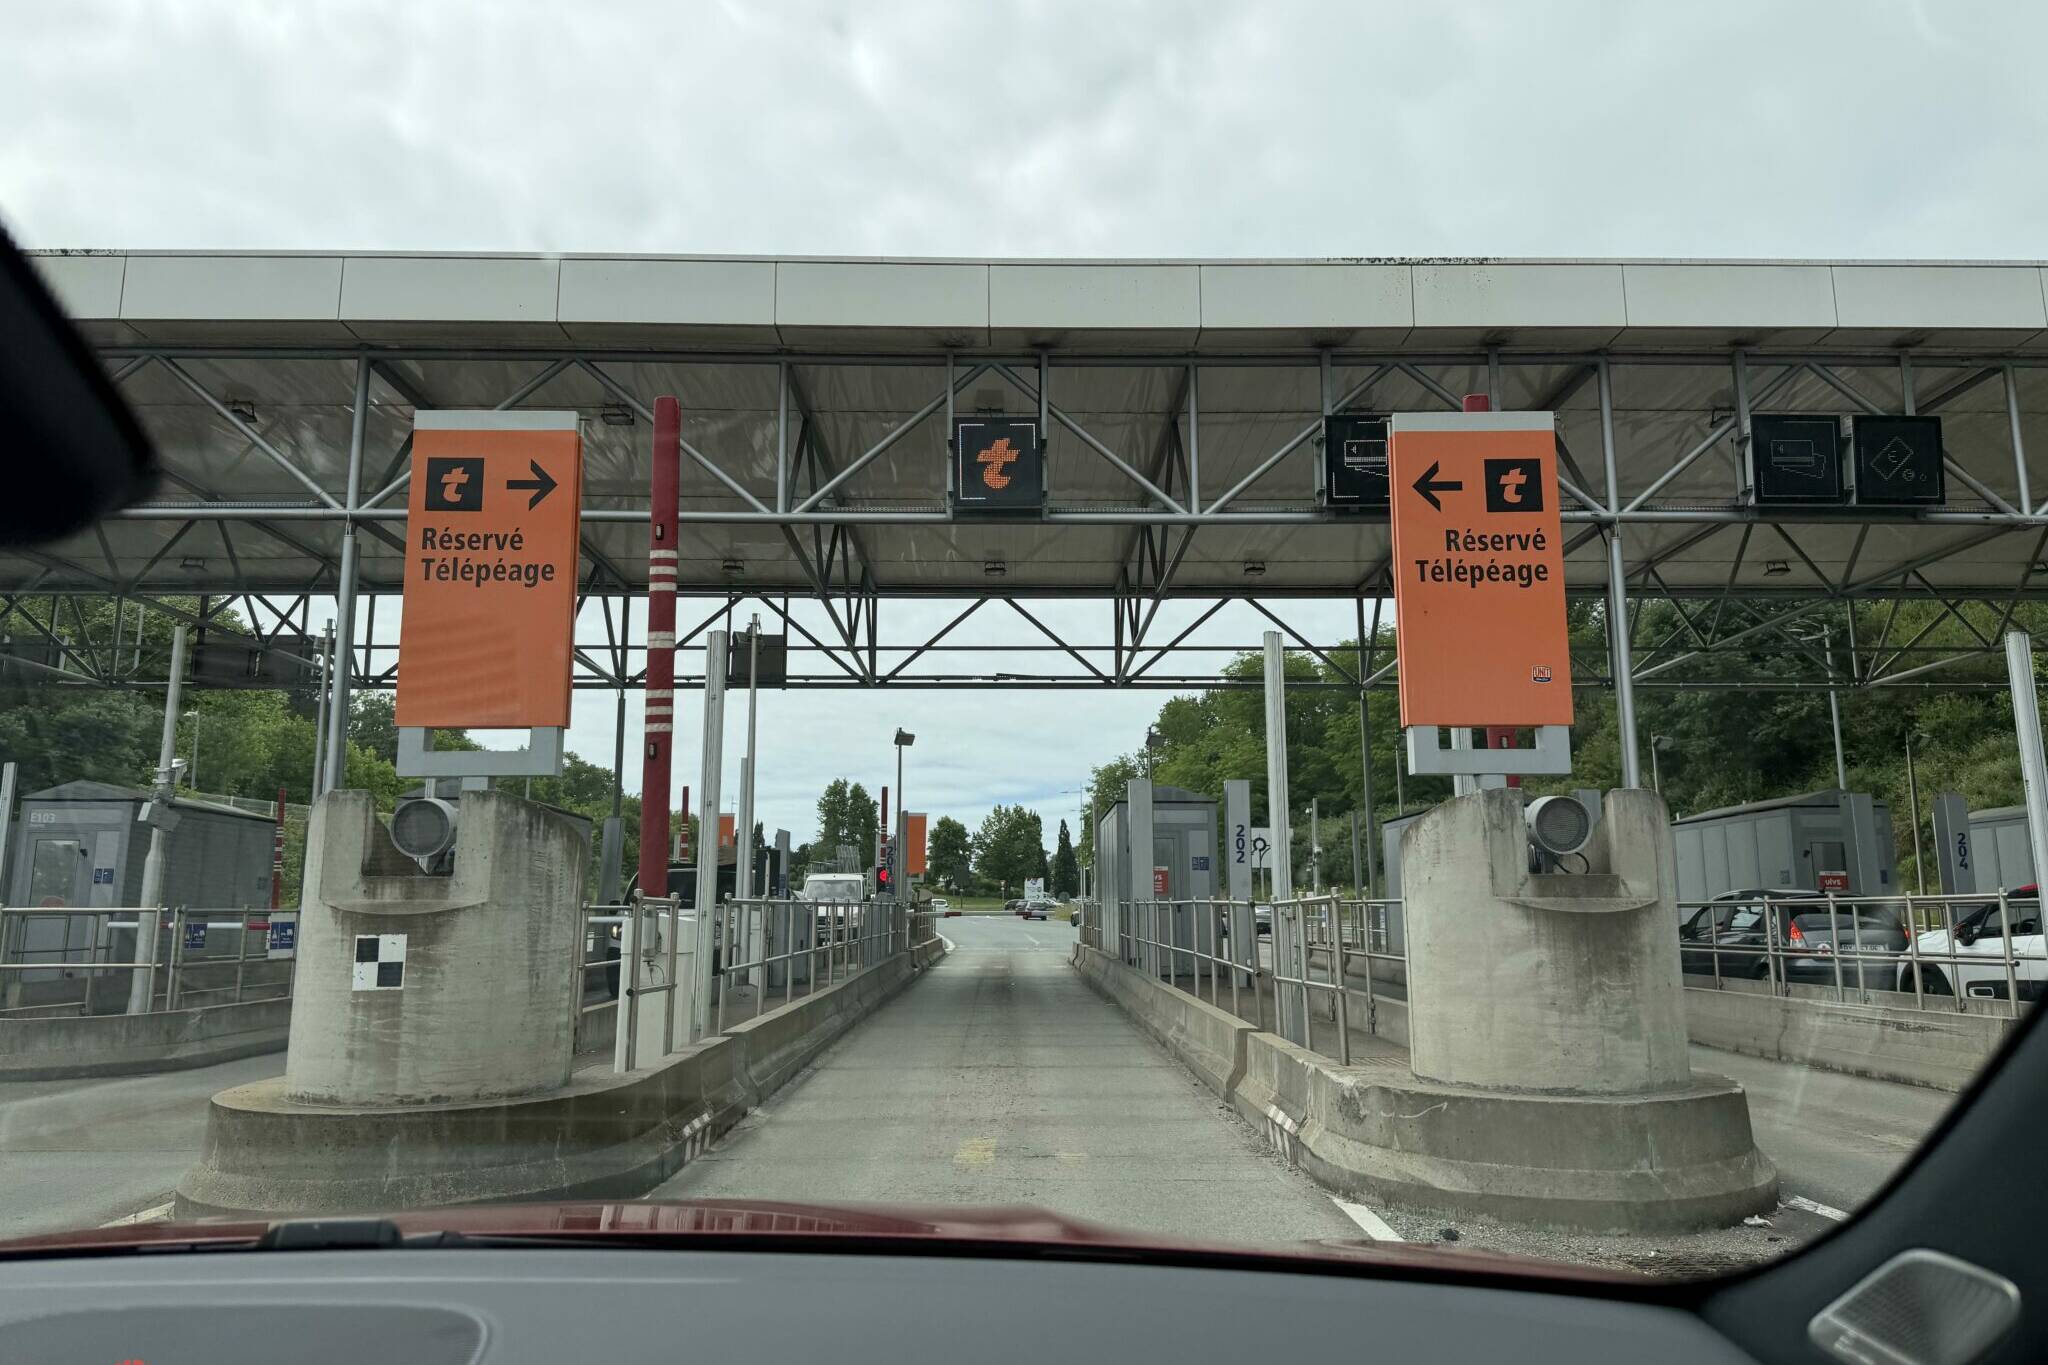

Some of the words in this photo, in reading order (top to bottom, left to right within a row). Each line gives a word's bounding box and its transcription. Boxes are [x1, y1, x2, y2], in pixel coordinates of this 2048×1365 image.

[421, 526, 523, 551] Réservé
[1445, 527, 1547, 552] Réservé
[421, 556, 555, 588] Télépéage
[1415, 558, 1549, 588] Télépéage
[1236, 824, 1246, 864] 202
[1957, 832, 1968, 870] 204
